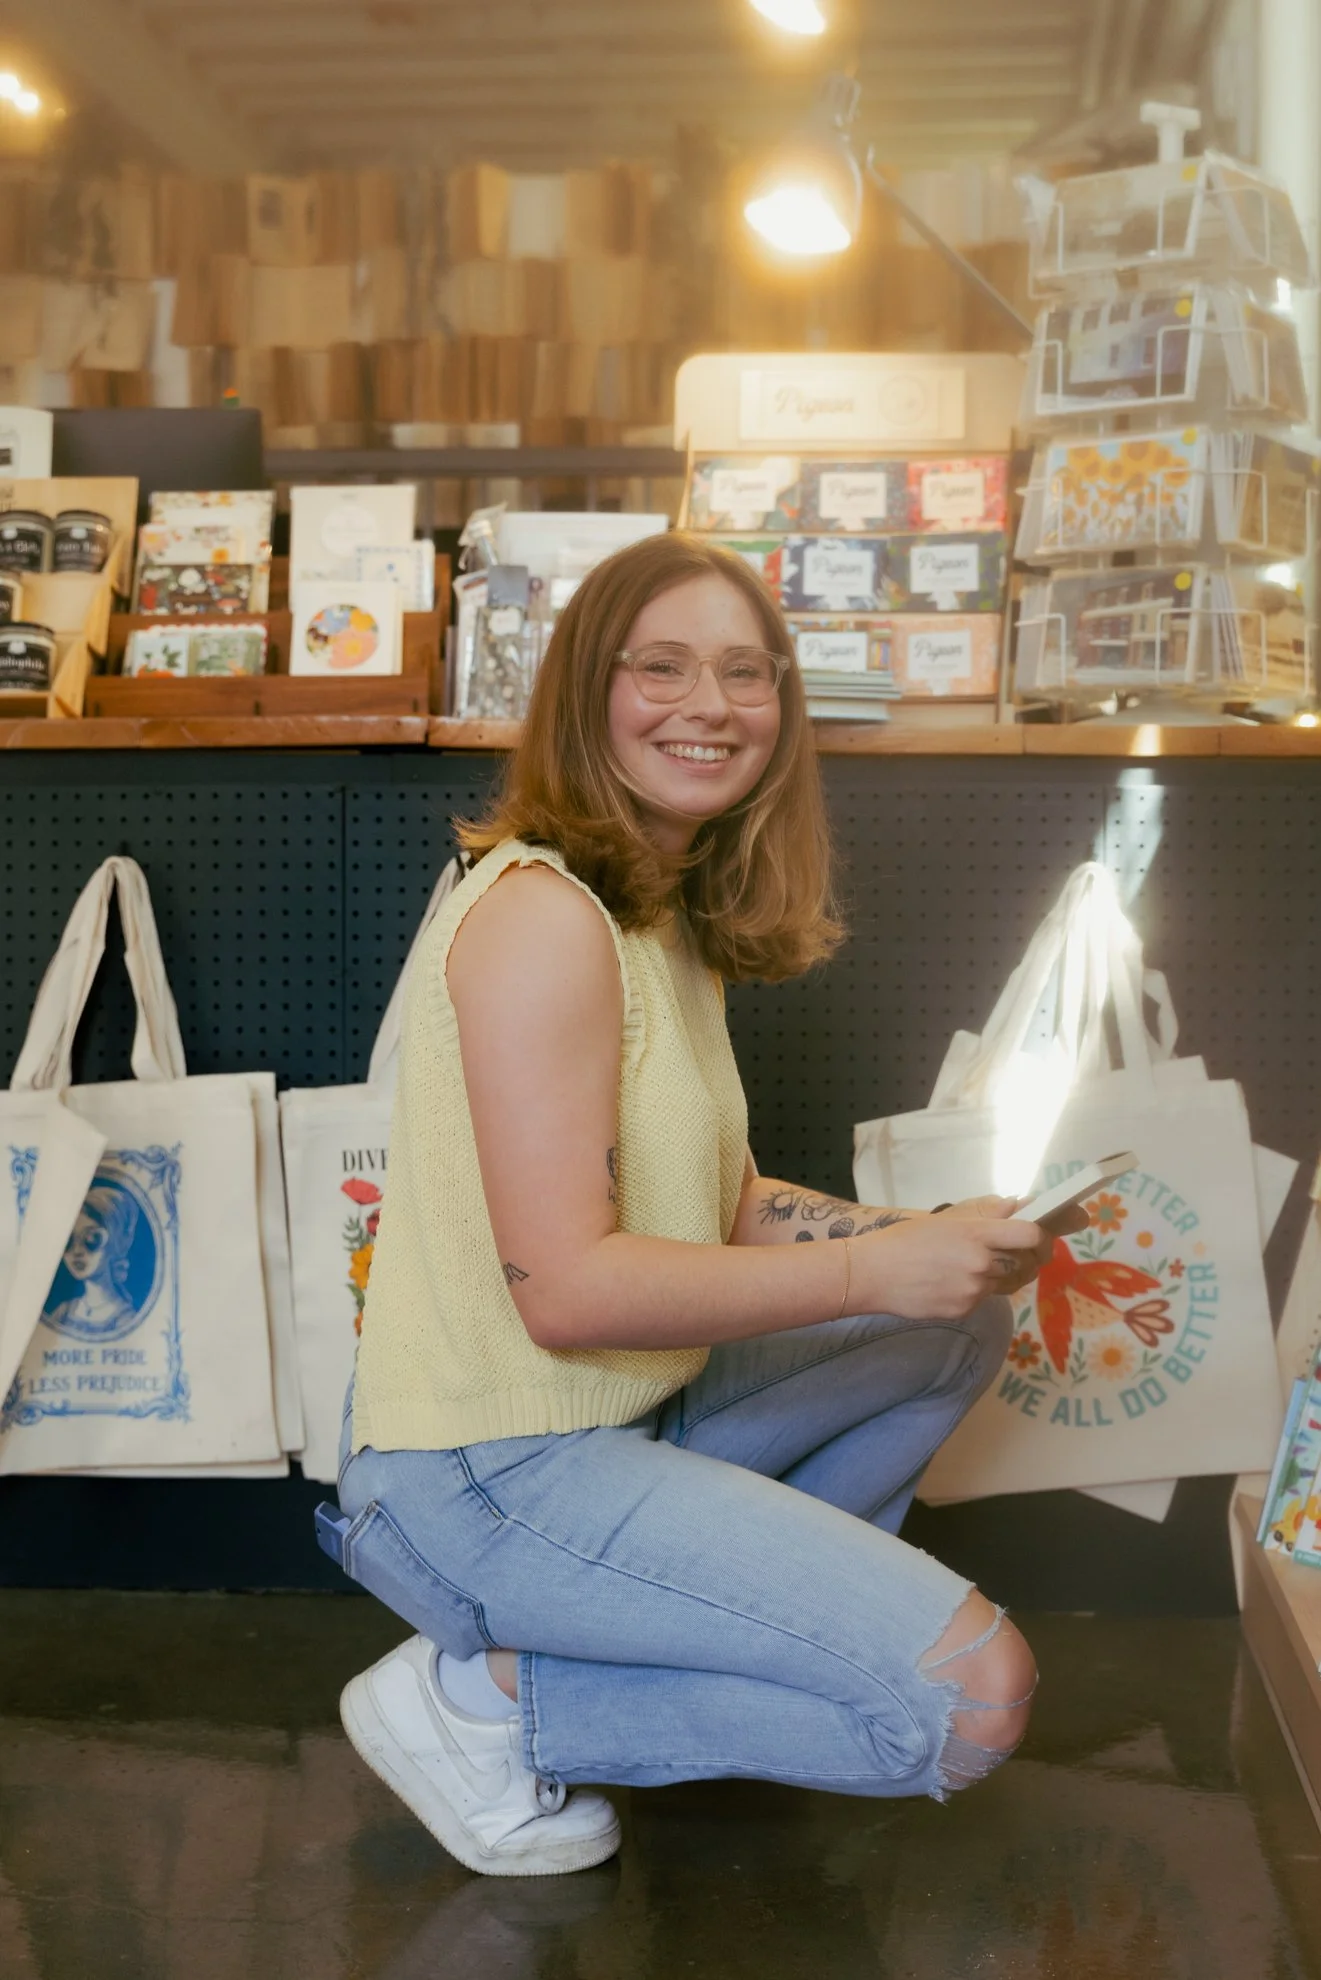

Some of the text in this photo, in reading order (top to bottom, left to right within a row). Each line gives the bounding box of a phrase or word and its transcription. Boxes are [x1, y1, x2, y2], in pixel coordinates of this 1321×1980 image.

[1110, 1169, 1199, 1235] ETTER
[43, 1348, 147, 1366] MORE PRIDE
[998, 1261, 1219, 1427] WE ALL DO BETTER
[29, 1374, 163, 1394] LESS PREJUDICE
